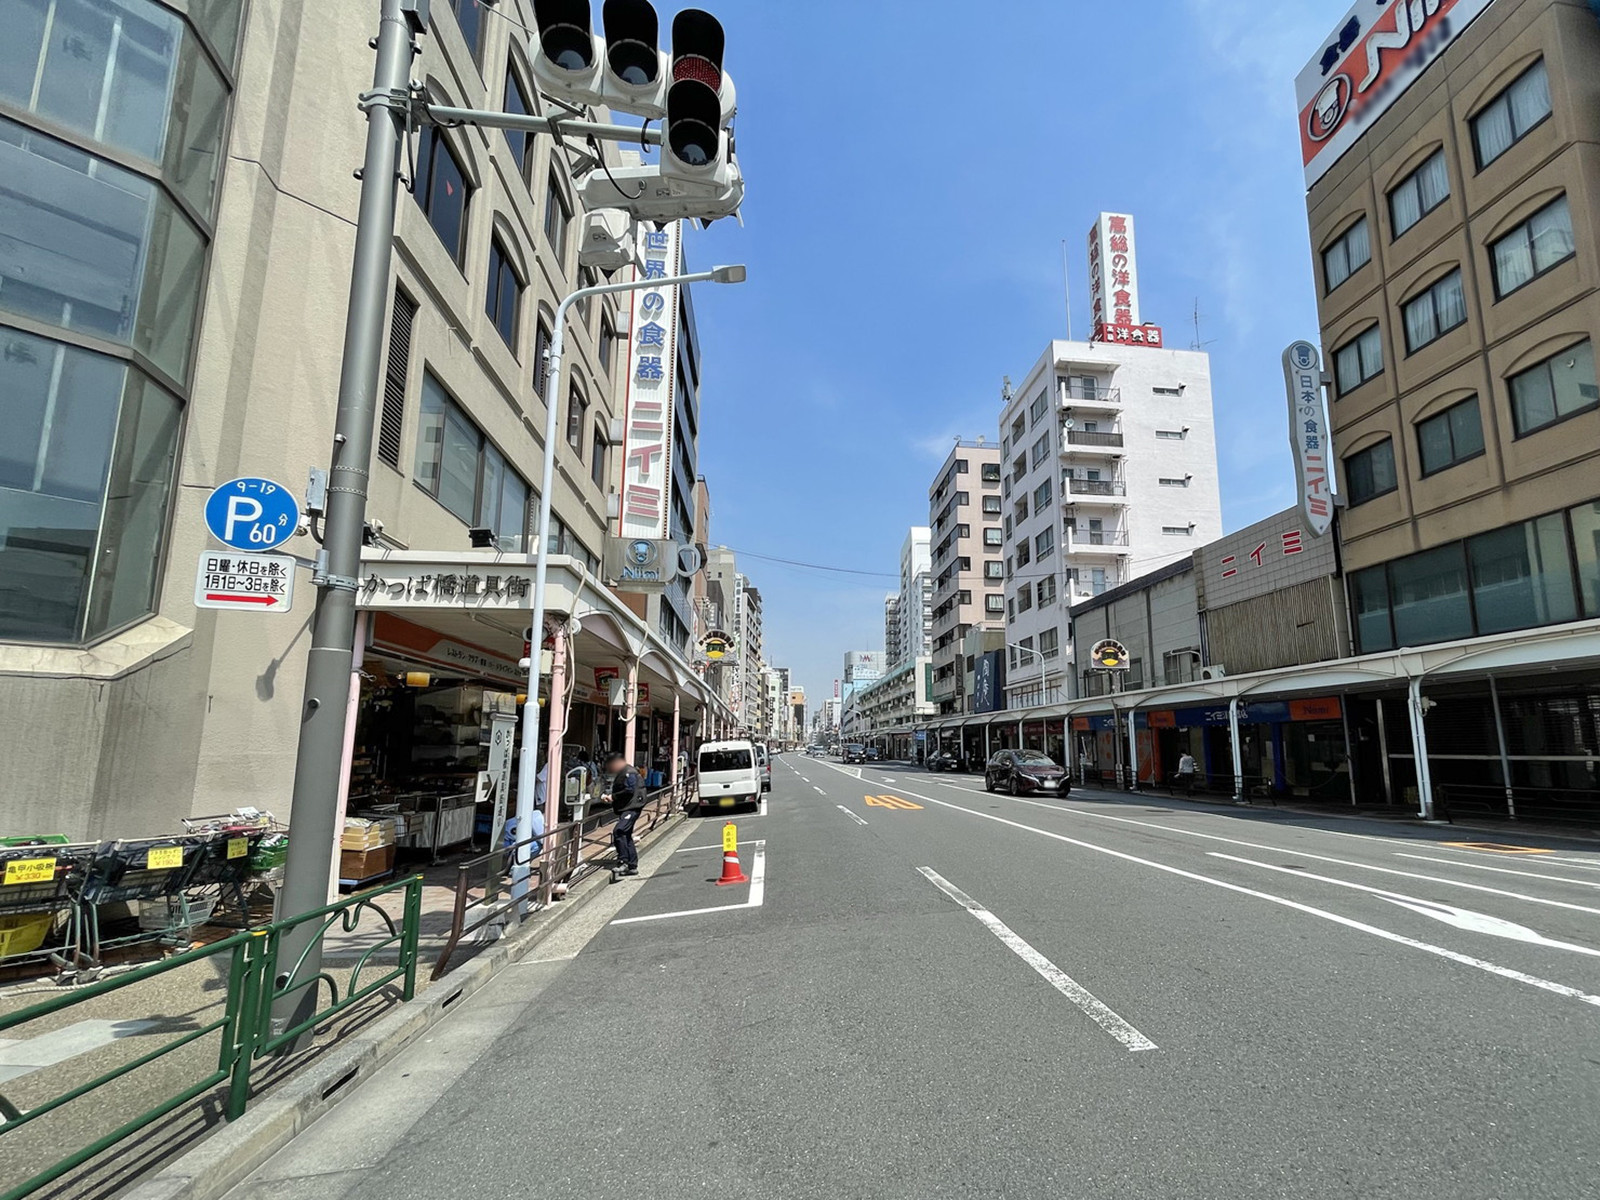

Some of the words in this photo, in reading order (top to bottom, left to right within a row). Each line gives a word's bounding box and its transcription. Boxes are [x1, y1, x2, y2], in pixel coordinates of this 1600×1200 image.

[637, 230, 669, 380] 世界の食器
[1116, 327, 1160, 343] 洋食器
[1300, 374, 1319, 449] 日本の食器
[627, 401, 663, 518] ニイミ
[236, 481, 276, 495] 9-19
[1306, 455, 1328, 517] ニイミ
[224, 495, 263, 541] P
[206, 558, 287, 577] 日曜・休日を除く
[1221, 530, 1303, 577] ニイミ
[362, 573, 531, 598] かっぱ橋道具街
[621, 565, 660, 580] Niimi
[864, 795, 925, 810] 40
